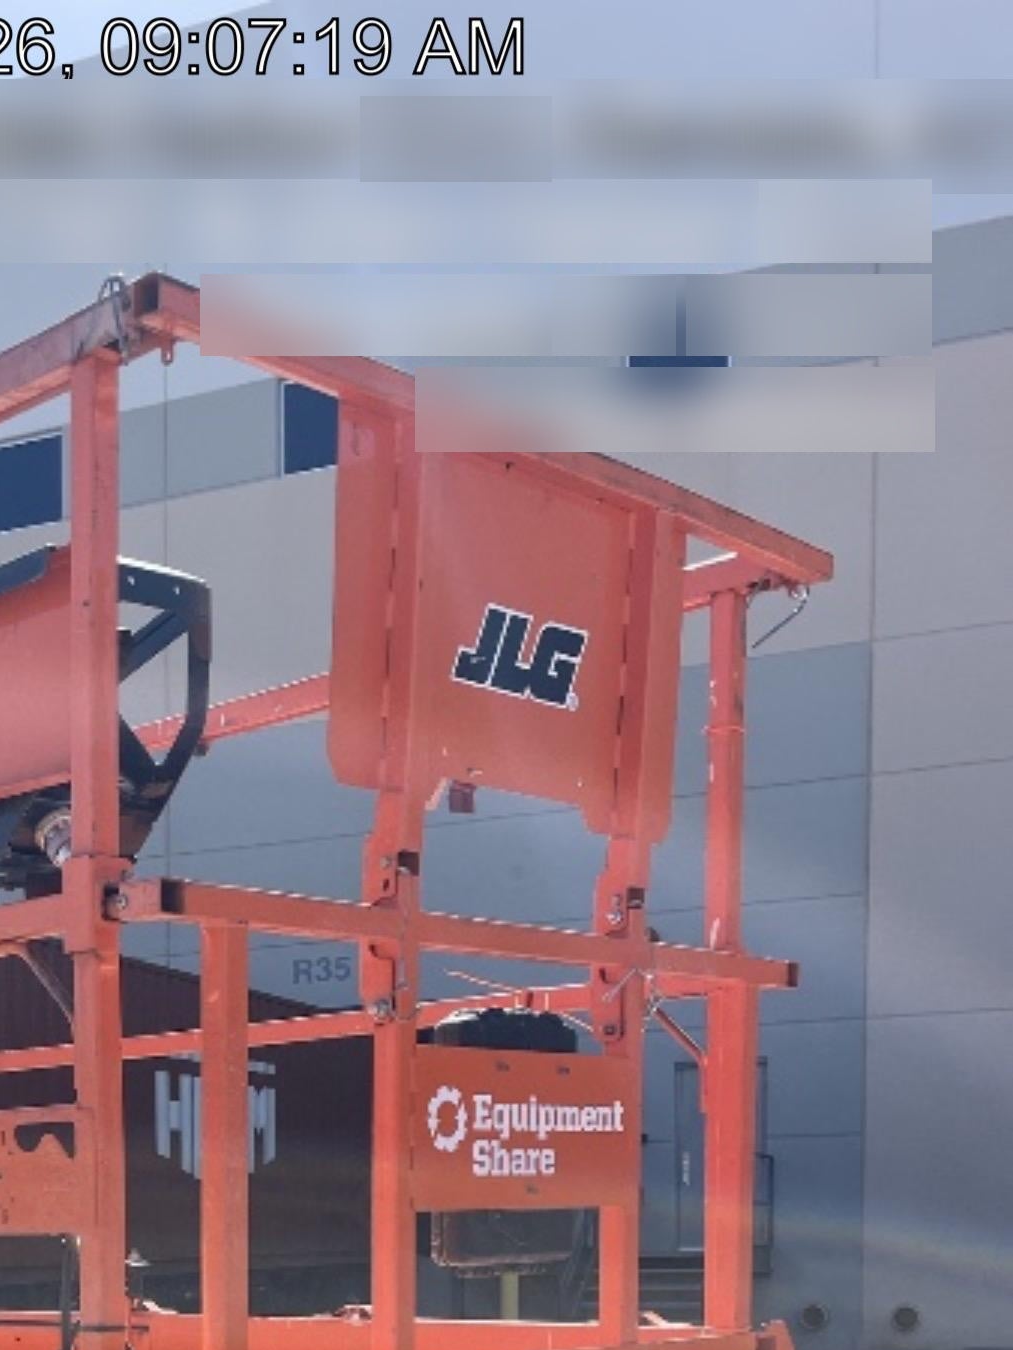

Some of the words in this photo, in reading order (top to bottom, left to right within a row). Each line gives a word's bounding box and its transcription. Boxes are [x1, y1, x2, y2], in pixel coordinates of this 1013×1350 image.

[452, 604, 587, 706] JLG
[292, 957, 352, 985] R35
[472, 1093, 624, 1140] Equipment
[472, 1140, 555, 1176] Share
